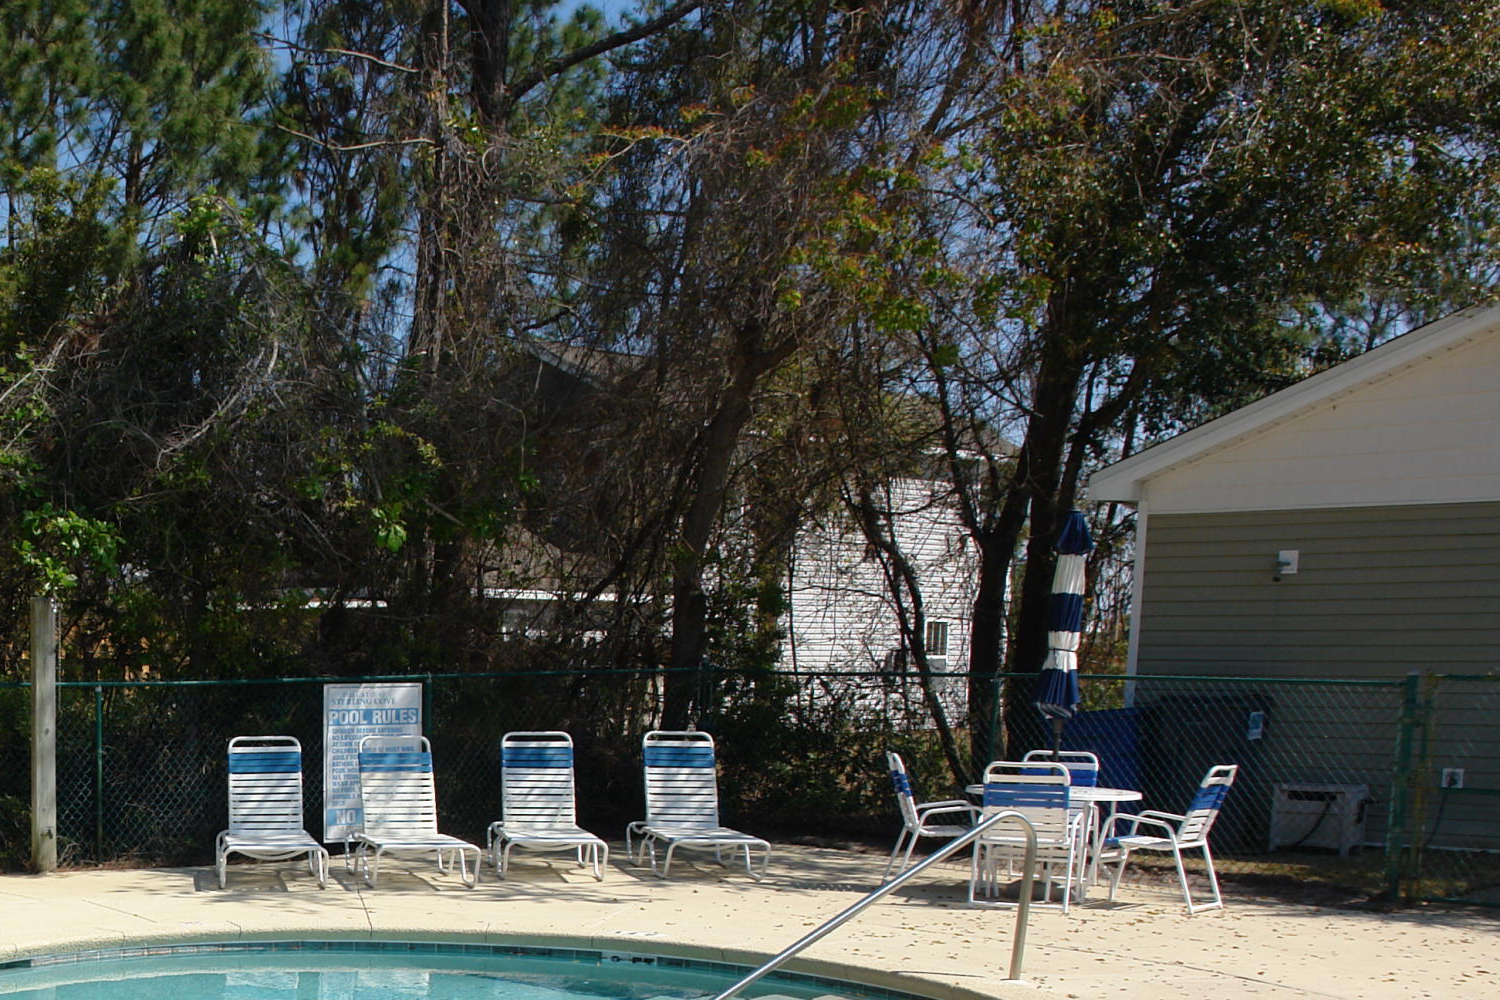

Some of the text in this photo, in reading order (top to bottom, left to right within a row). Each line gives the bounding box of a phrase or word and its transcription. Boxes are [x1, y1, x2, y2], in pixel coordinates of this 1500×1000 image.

[328, 708, 417, 725] POOL RULES
[336, 809, 357, 825] NO
